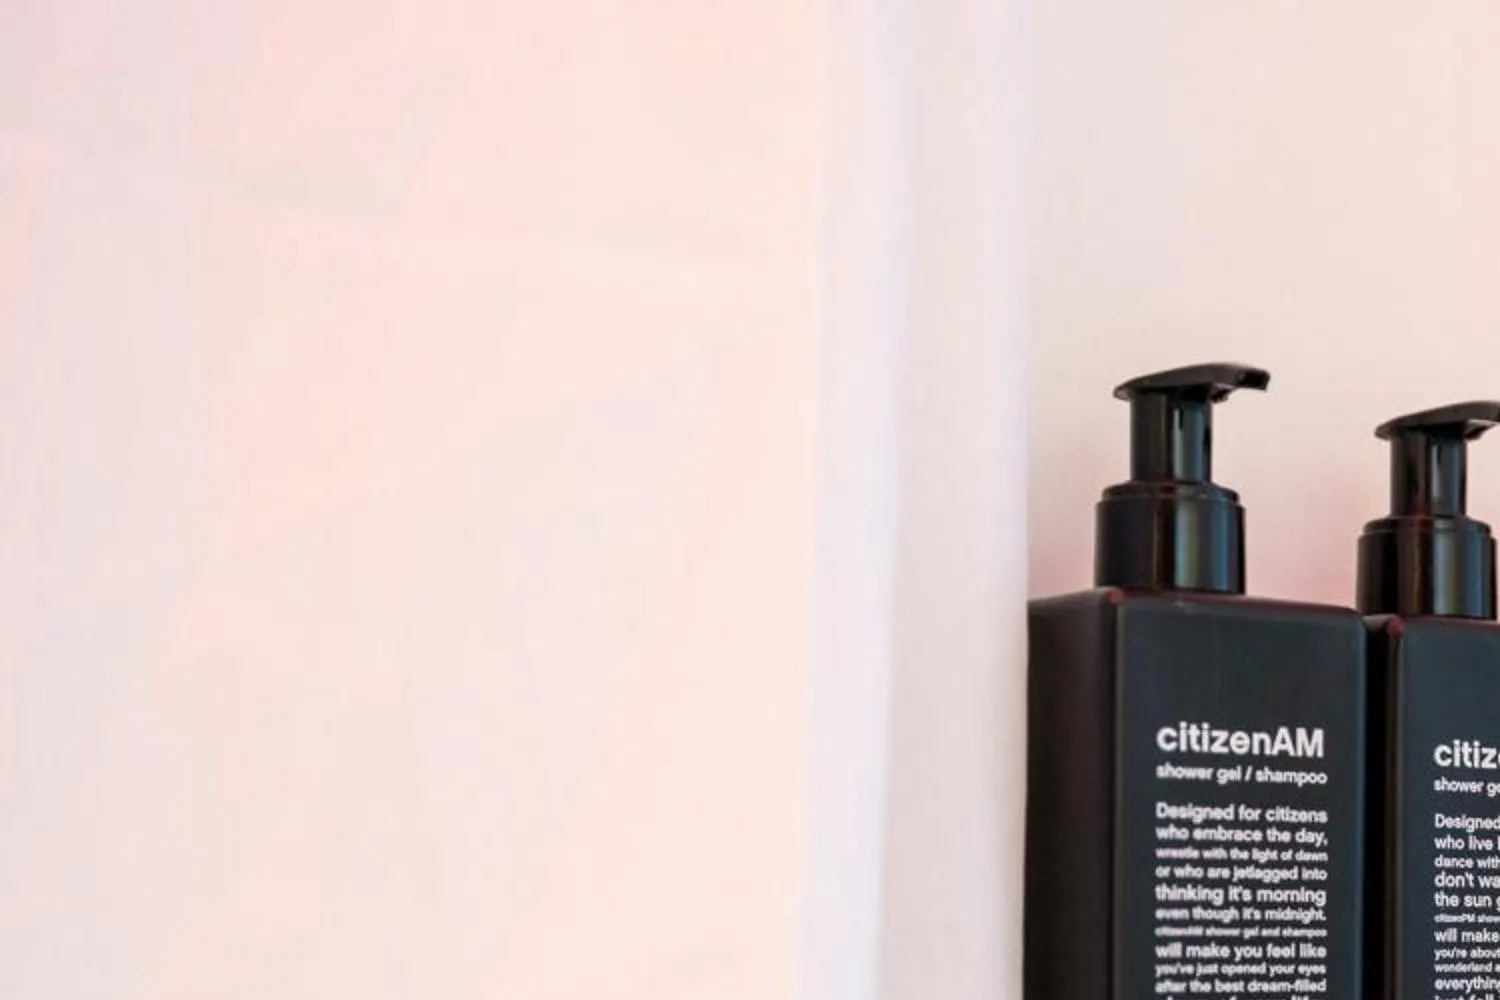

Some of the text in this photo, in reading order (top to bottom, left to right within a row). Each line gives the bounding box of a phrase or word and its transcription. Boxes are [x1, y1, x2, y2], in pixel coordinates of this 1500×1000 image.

[1156, 721, 1324, 758] citizenAM
[1156, 761, 1328, 787] shower gel / shampoo
[1433, 776, 1484, 793] shower
[1156, 802, 1328, 823] Designed for citizens
[1156, 824, 1328, 846] who embrace the day,
[1433, 835, 1465, 850] who
[1468, 835, 1493, 850] live
[1434, 854, 1474, 868] dance
[1155, 865, 1170, 878] or
[1173, 863, 1203, 878] who
[1207, 865, 1230, 879] are
[1302, 866, 1328, 880] into
[1434, 871, 1474, 888] don't
[1155, 883, 1326, 907] thinking it's morning
[1434, 891, 1459, 907] the
[1463, 894, 1492, 908] sun
[1155, 906, 1327, 924] even though it's midnight.
[1434, 928, 1457, 942] will
[1461, 928, 1500, 943] make
[1156, 943, 1327, 962] will make you feel like
[1434, 947, 1467, 960] you're
[1470, 947, 1500, 958] about
[1155, 962, 1326, 977] you've just opened your eyes
[1155, 979, 1187, 993] after
[1189, 979, 1211, 993] the
[1214, 978, 1244, 992] best
